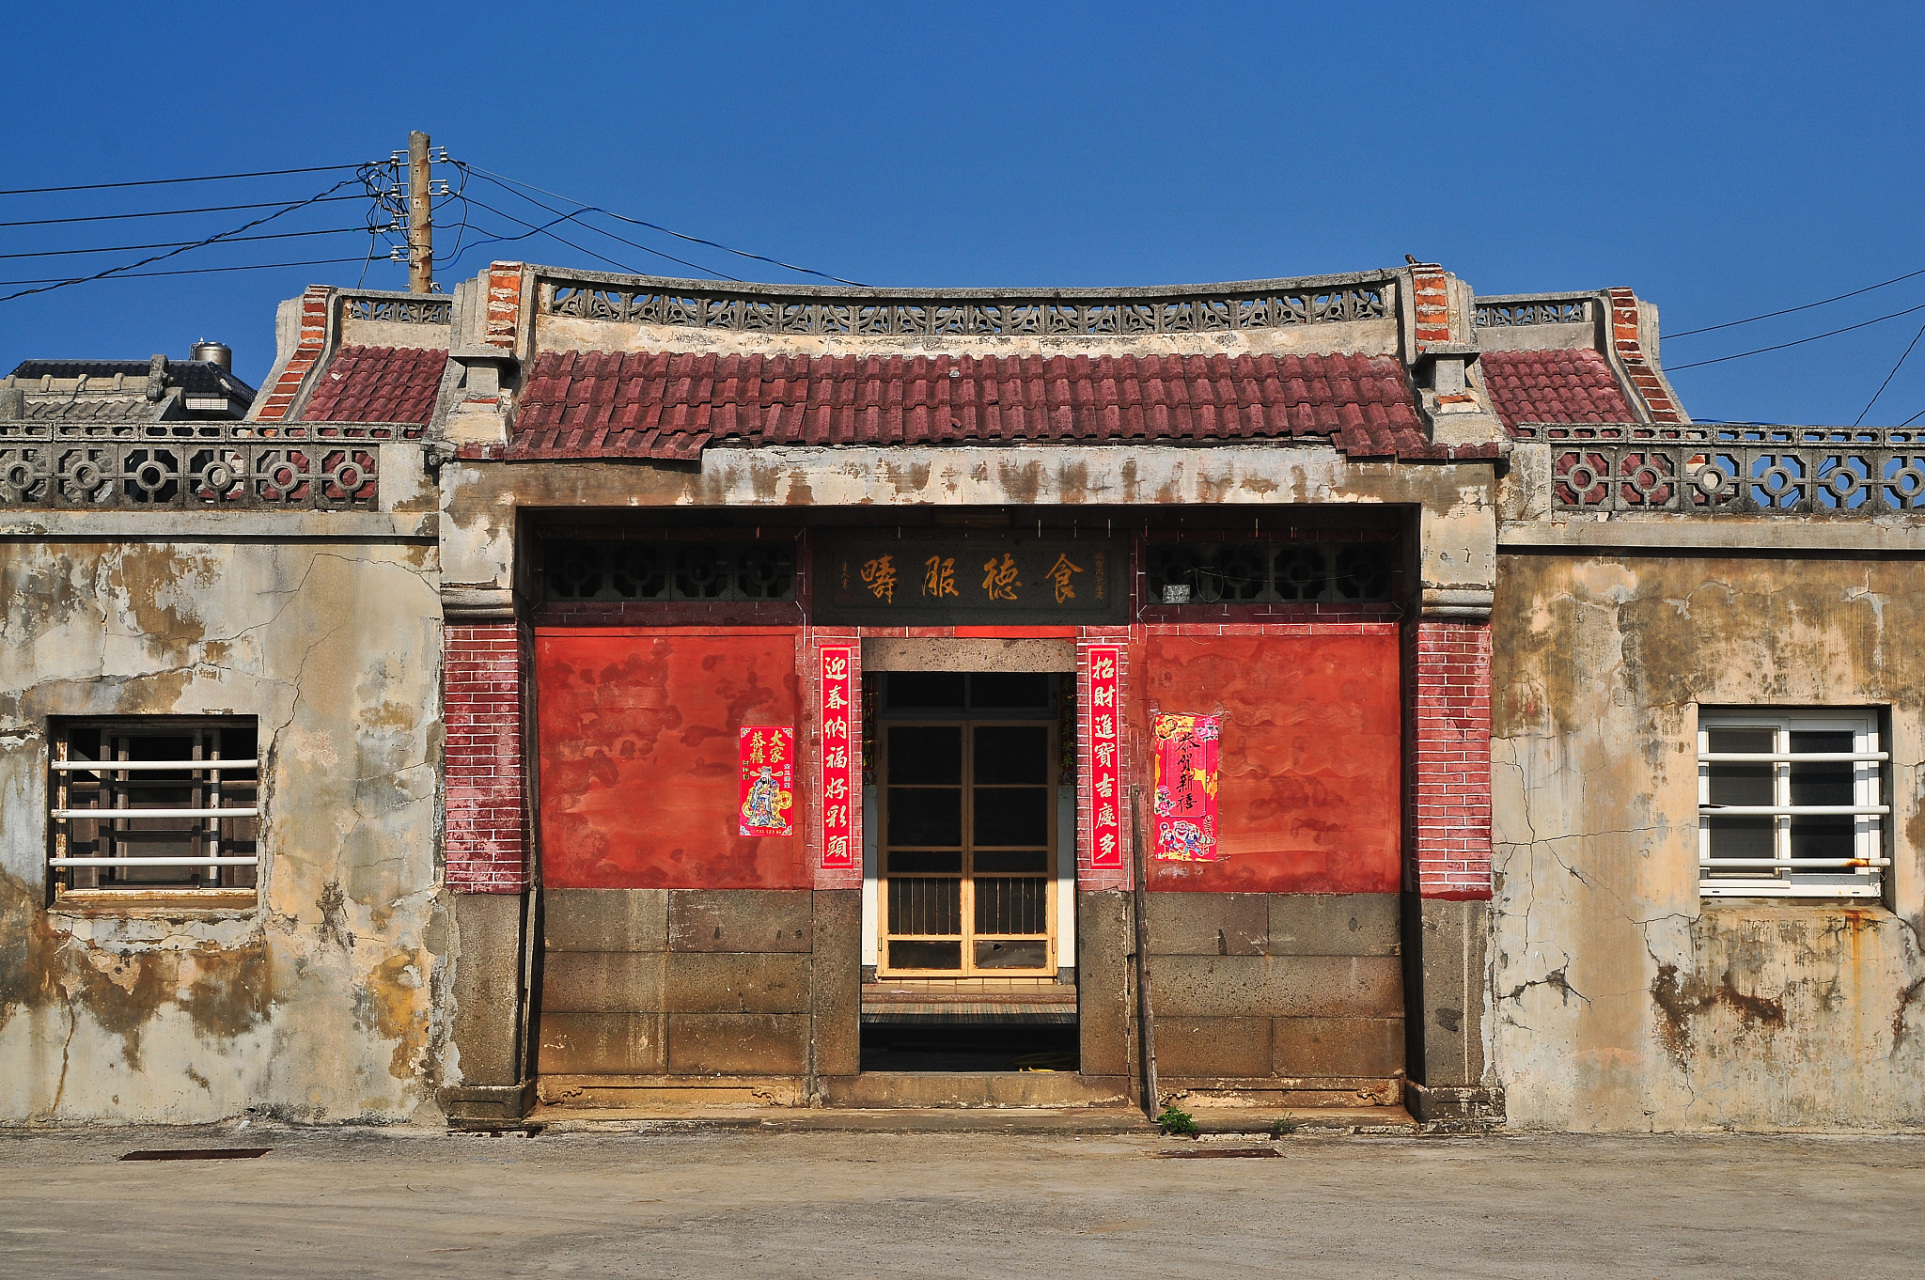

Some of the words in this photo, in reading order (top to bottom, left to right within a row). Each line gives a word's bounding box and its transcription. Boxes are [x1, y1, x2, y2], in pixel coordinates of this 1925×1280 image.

[769, 730, 785, 763] 大家
[824, 656, 848, 858] 迎春納福好彩頭
[1092, 656, 1117, 860] 招財進寶吉慶多
[1175, 732, 1201, 813] 恭賀新禧
